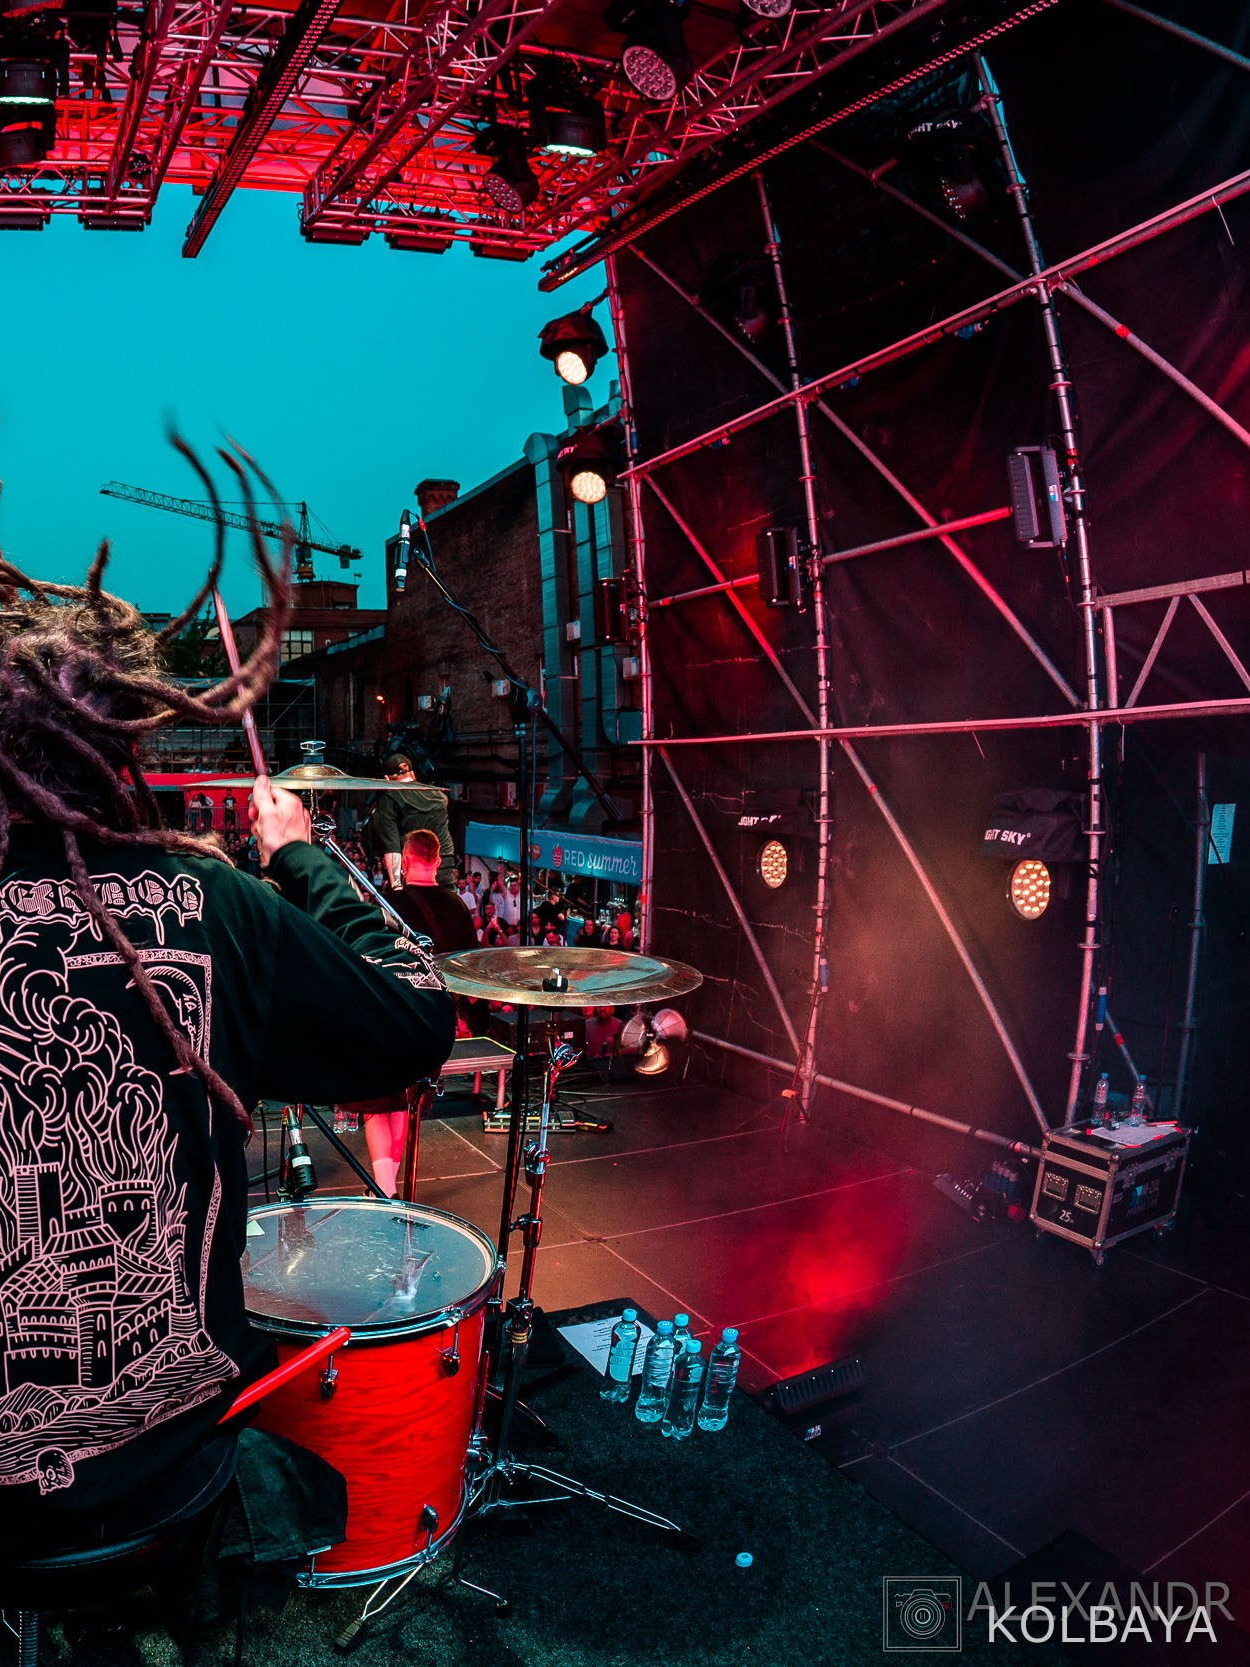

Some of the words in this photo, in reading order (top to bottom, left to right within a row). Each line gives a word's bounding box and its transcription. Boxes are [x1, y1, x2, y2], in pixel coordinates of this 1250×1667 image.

[564, 849, 585, 868] RED
[587, 852, 638, 877] summer
[1058, 1209, 1071, 1223] 25
